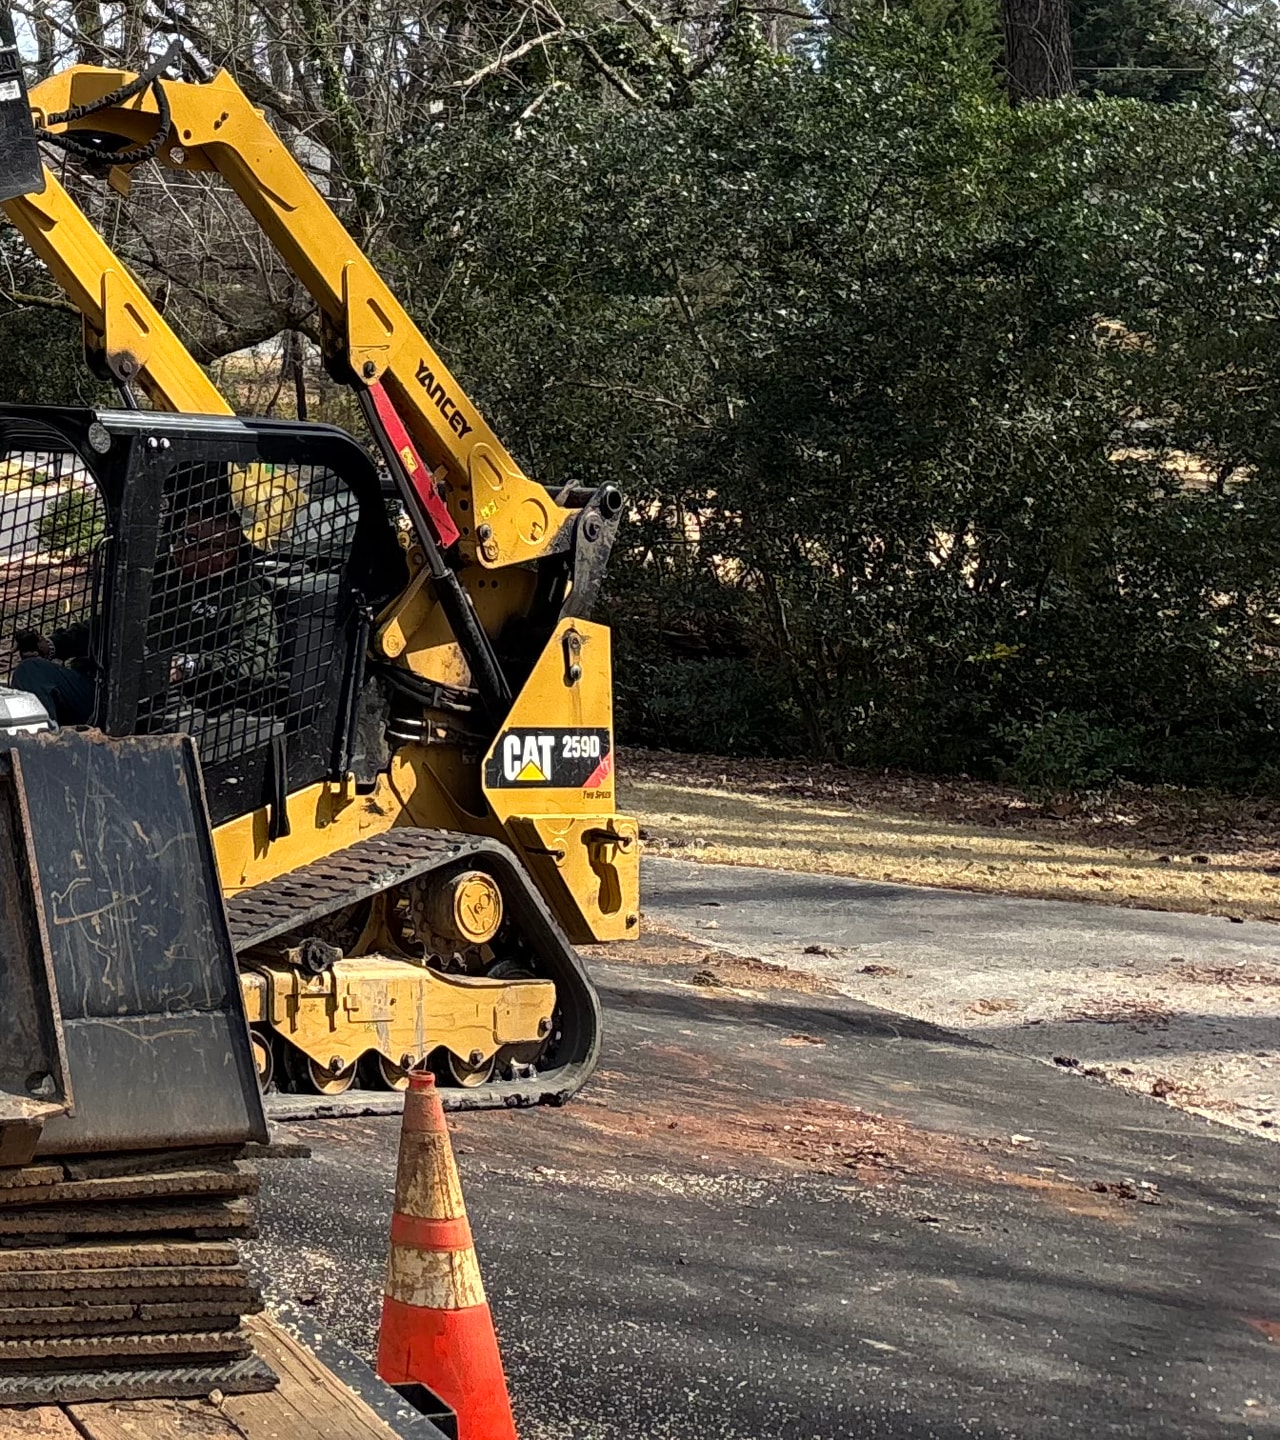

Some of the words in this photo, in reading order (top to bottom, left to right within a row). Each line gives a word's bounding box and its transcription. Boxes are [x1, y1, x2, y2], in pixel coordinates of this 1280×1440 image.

[415, 358, 473, 440] YANCEY
[503, 734, 555, 781] CAT
[562, 735, 600, 758] 259D
